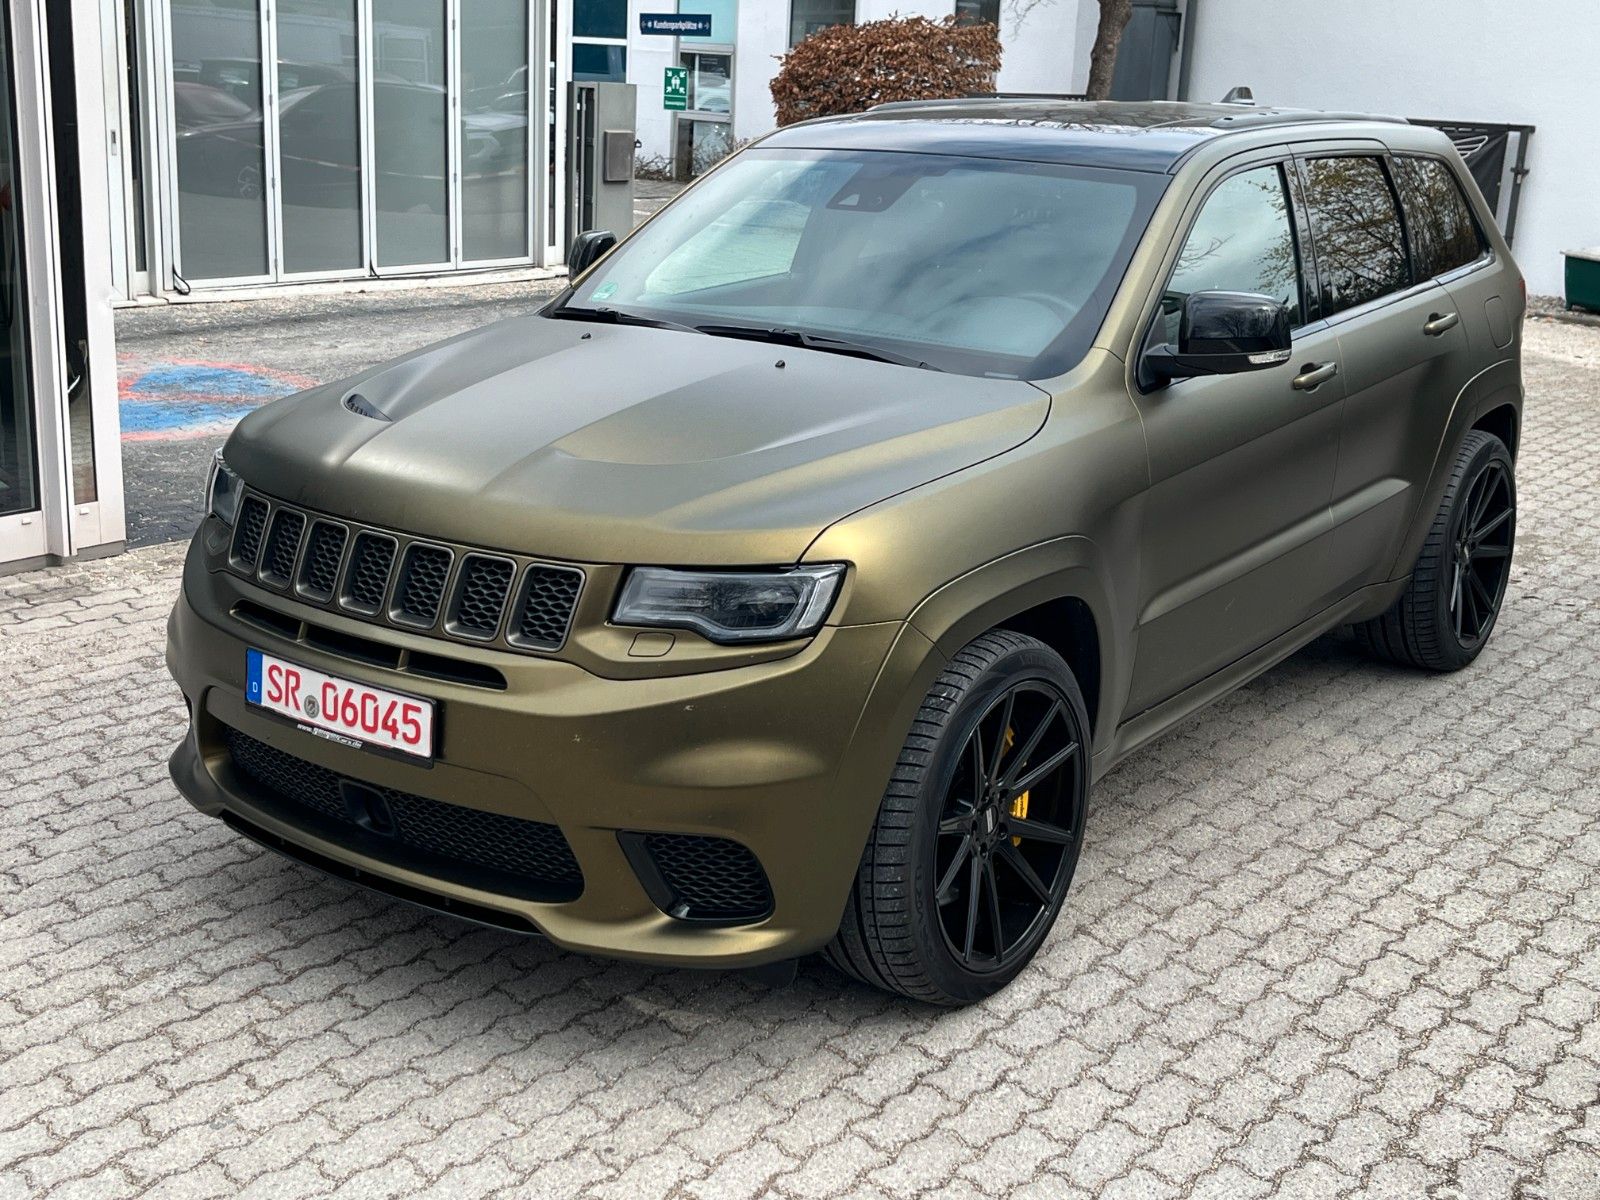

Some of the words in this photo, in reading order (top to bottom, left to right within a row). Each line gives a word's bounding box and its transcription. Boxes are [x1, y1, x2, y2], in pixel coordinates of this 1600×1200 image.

[252, 681, 259, 693] D
[267, 664, 301, 711] SR
[321, 681, 422, 745] 06045
